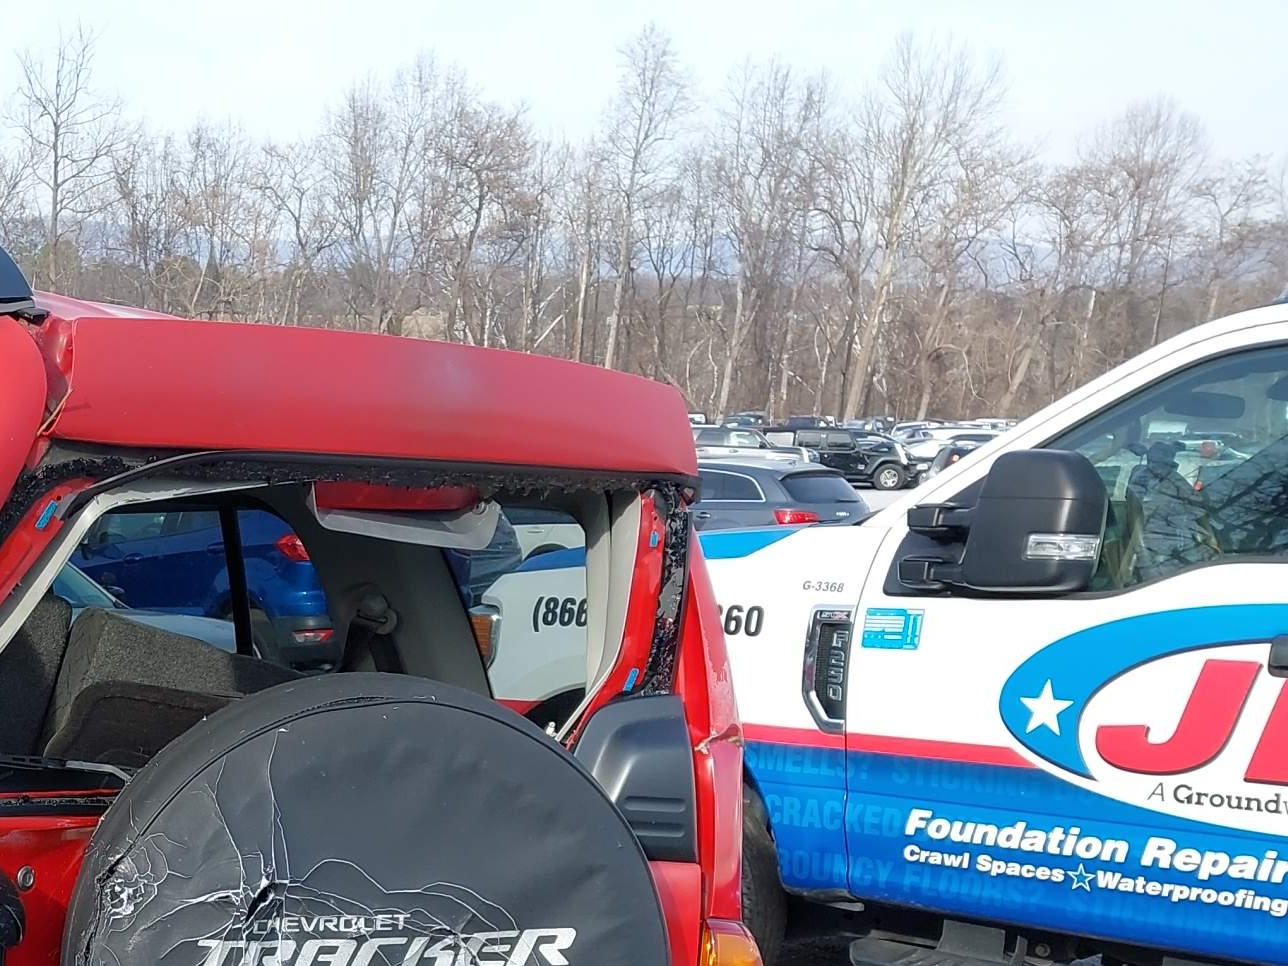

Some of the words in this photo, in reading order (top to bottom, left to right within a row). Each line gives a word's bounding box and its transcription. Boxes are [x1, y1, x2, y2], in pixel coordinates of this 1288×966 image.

[802, 580, 844, 593] G-3368
[532, 597, 587, 632] (866
[717, 604, 763, 637] 60
[1147, 782, 1165, 801] A
[767, 793, 903, 838] CRACKED
[904, 808, 1129, 863] Foundation
[1140, 836, 1288, 884] Repair
[903, 844, 970, 869] Crawl
[975, 854, 1065, 883] Spaces
[1095, 870, 1288, 918] Waterproofing
[253, 913, 410, 935] CHEVROLET
